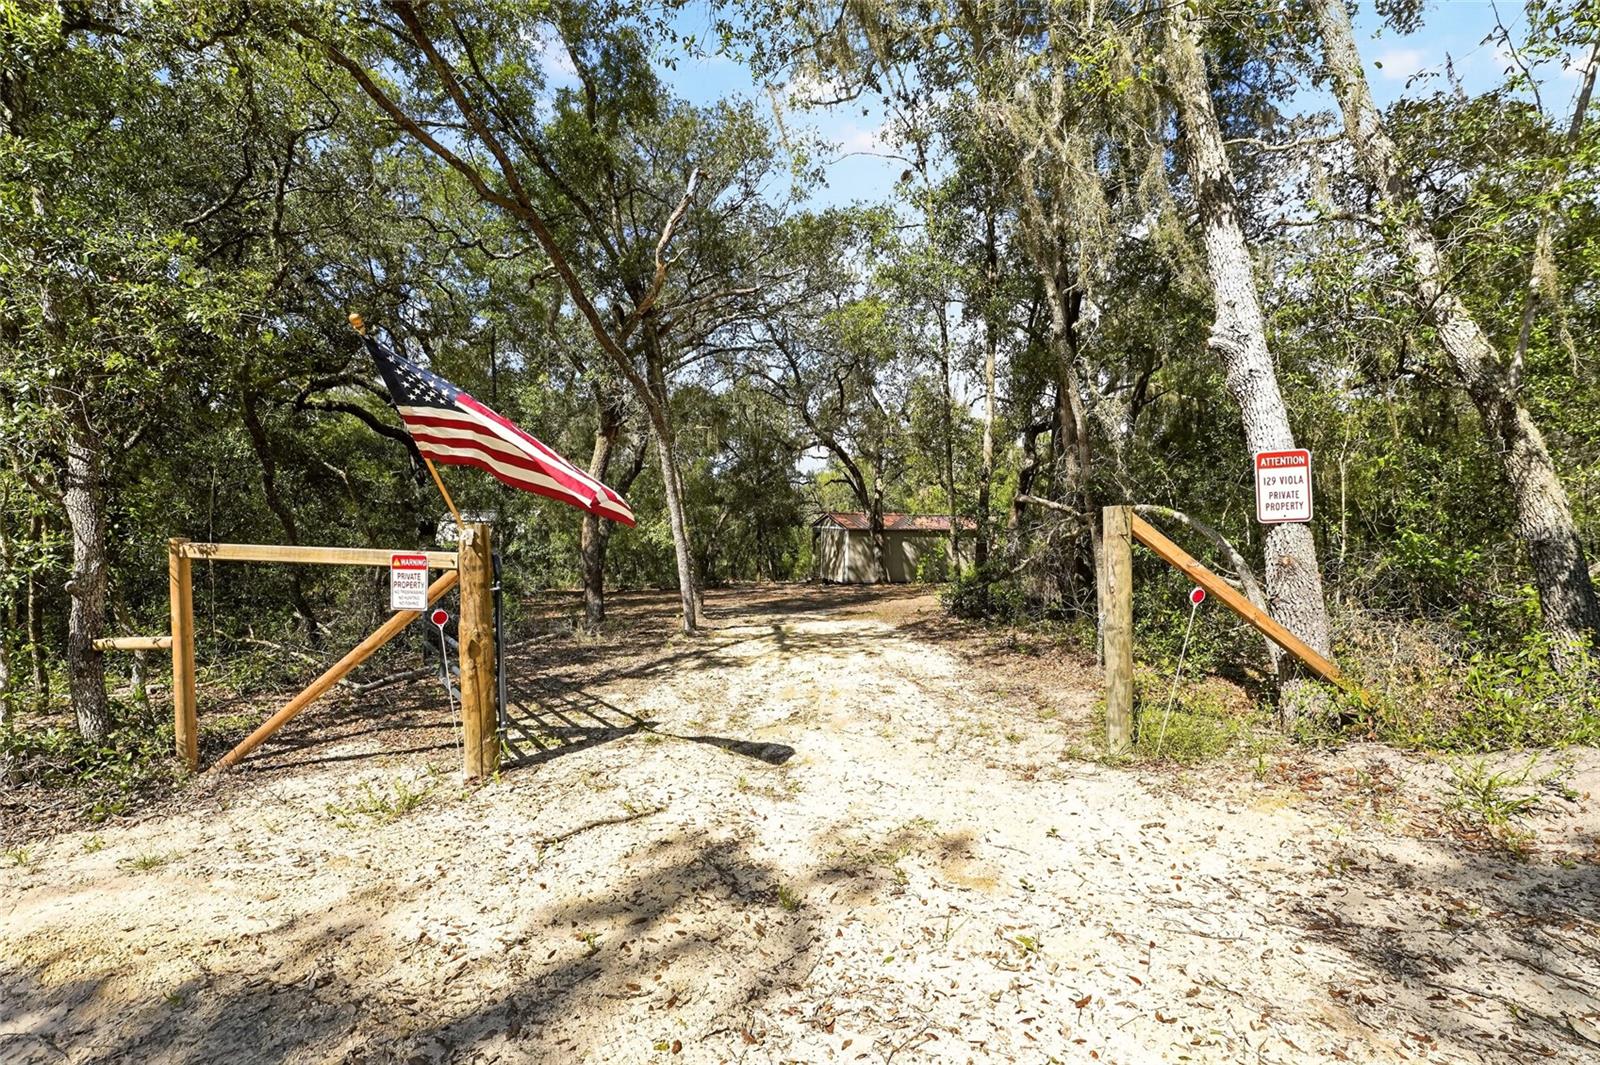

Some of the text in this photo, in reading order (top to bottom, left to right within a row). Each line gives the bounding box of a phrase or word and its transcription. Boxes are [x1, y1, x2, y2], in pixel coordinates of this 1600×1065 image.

[1261, 456, 1305, 466] ATTENTION
[1263, 475, 1304, 486] 129 VIOLA
[1268, 490, 1300, 499] PRIVATE
[1265, 501, 1304, 511] PROPERTY
[400, 559, 427, 567] WARNING
[397, 572, 421, 581] PRIVATE
[393, 581, 425, 589] PROPERTY
